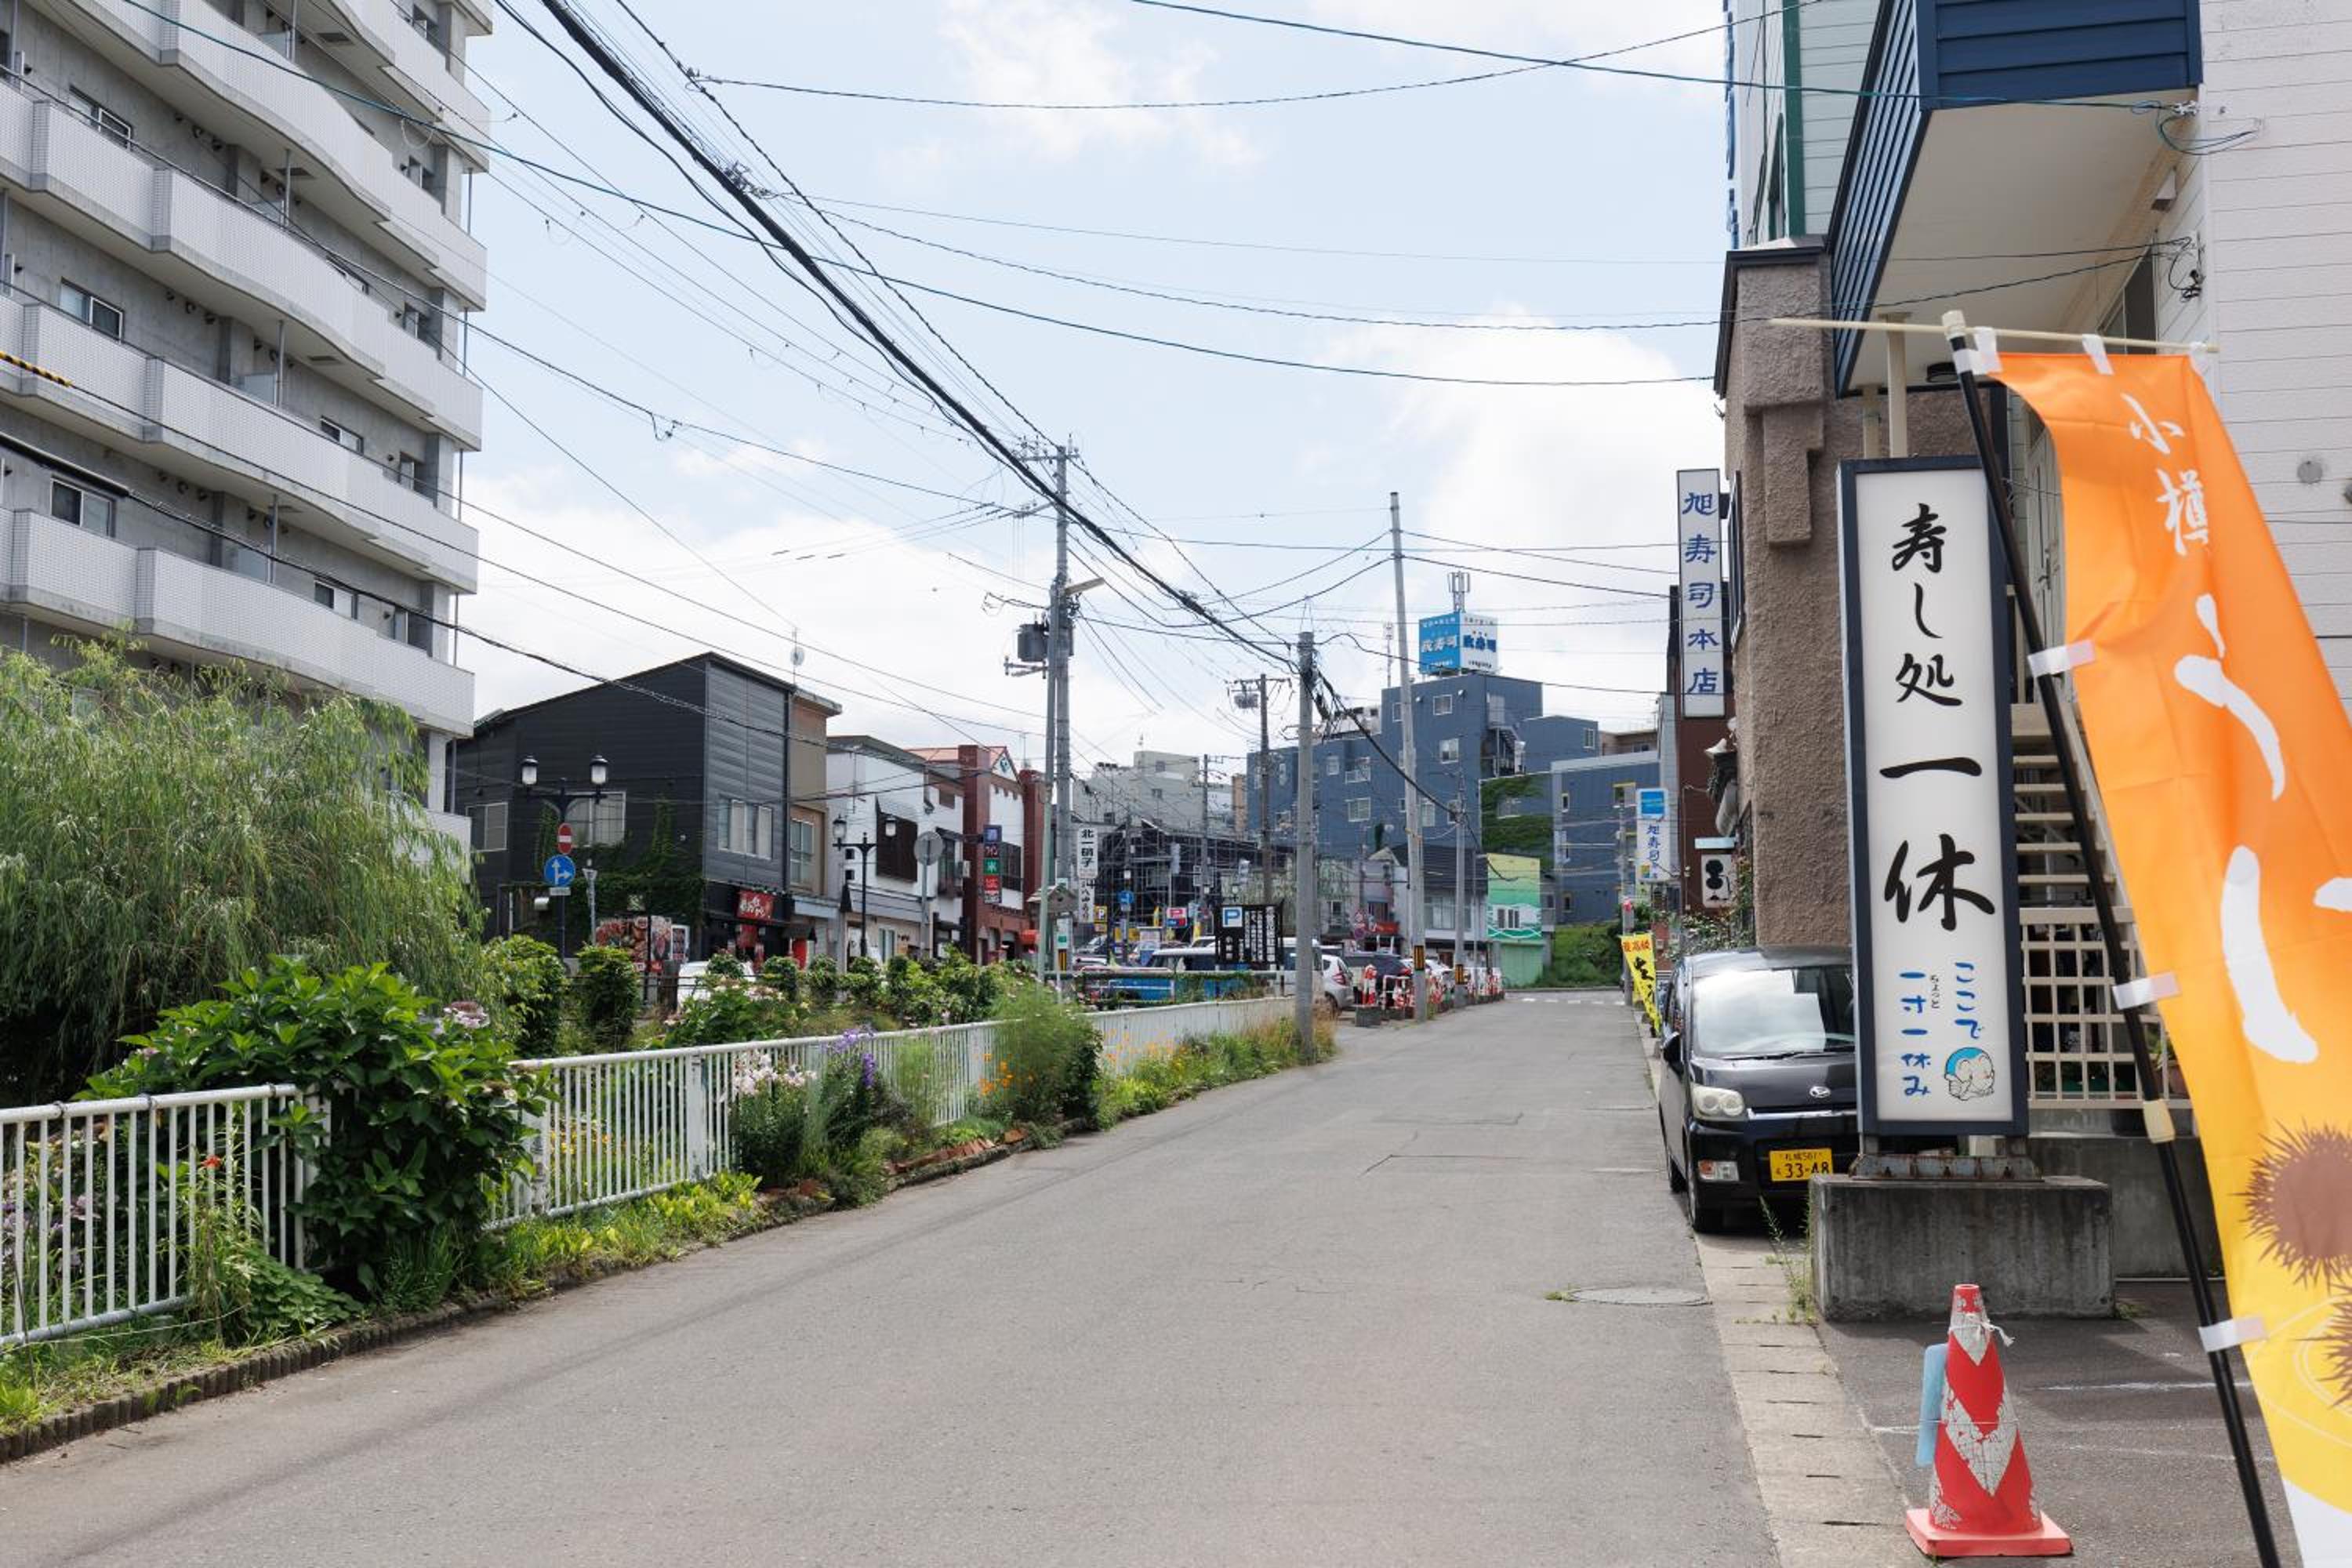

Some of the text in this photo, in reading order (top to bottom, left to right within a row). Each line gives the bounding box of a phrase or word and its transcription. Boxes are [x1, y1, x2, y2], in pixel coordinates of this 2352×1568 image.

[1682, 492, 1719, 695] 旭寿司本店
[1224, 909, 1241, 926] P
[1899, 971, 1932, 1097] 一寸一休み
[1955, 962, 1984, 1040] ここで
